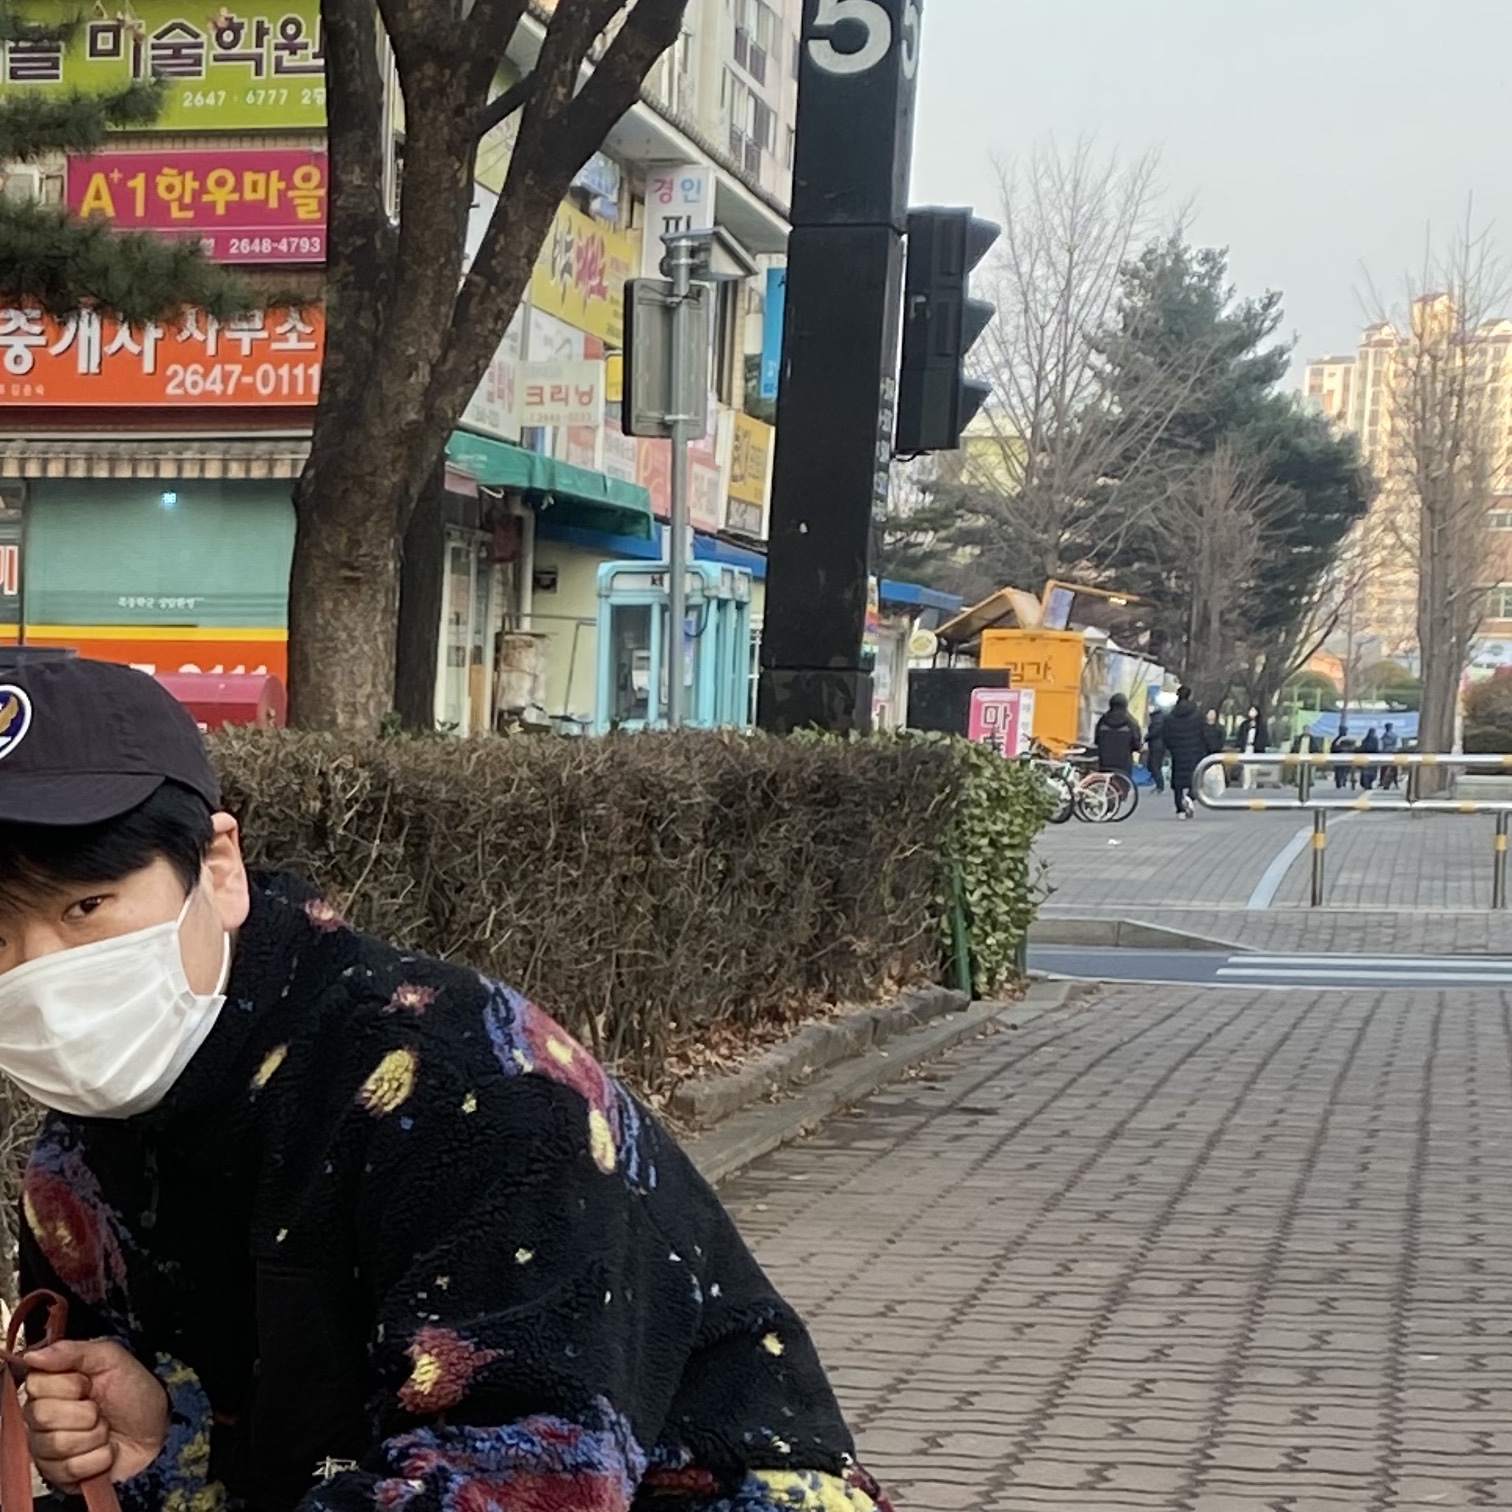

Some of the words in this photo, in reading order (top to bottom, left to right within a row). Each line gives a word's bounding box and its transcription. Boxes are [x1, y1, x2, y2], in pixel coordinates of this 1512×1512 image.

[808, 0, 892, 73] 5
[246, 88, 288, 105] 6777
[653, 178, 701, 204] 경인
[229, 238, 321, 254] 2648-4793
[165, 363, 320, 396] 2647-0111
